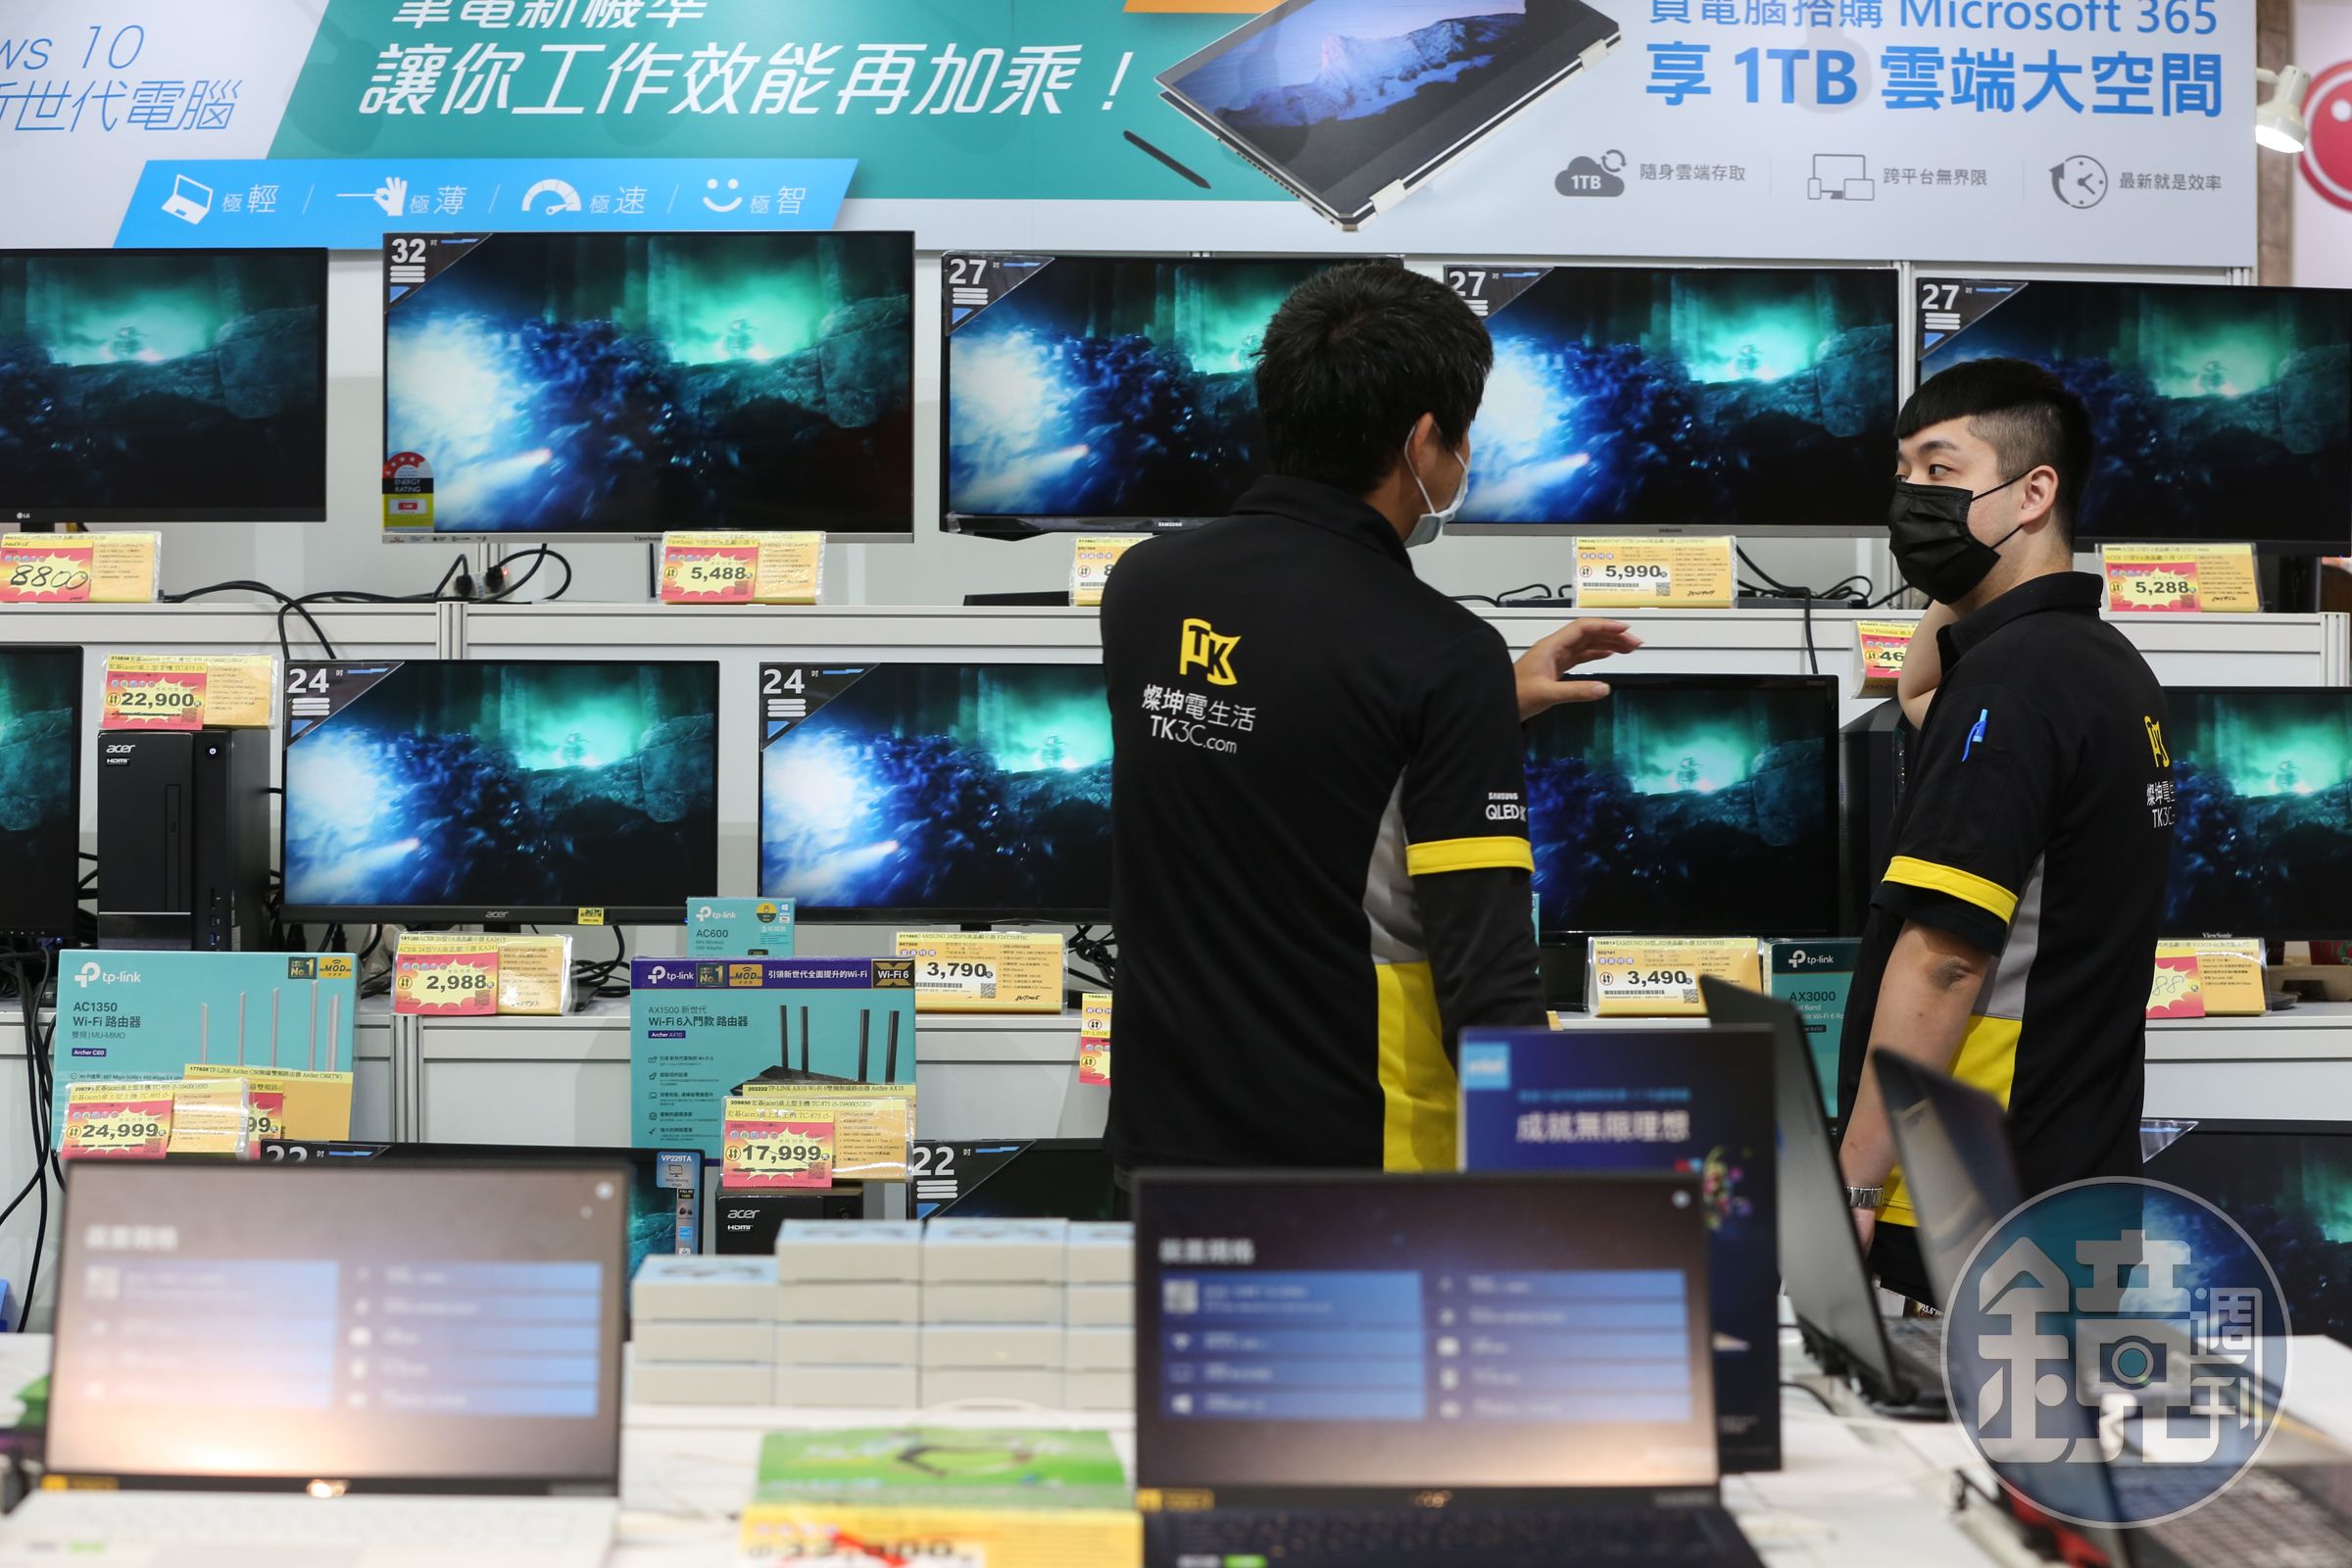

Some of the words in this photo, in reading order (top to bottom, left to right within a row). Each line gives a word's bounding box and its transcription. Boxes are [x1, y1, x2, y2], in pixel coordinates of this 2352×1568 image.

[1899, 0, 2120, 33] Microsoft
[2135, 0, 2218, 35] 365
[82, 24, 145, 70] 10
[1645, 41, 1711, 106] 享
[1734, 47, 1858, 106] 1TB
[1880, 45, 2223, 118] 雲端大空間
[1639, 163, 1746, 182] 隨身雲端存取
[1883, 168, 1988, 187] 跨平台無界限
[2119, 172, 2223, 191] 最新就是效率
[1570, 174, 1602, 190] 1TB
[220, 184, 280, 214] 極輕
[409, 185, 467, 215] 極薄
[588, 185, 647, 214] 極速
[749, 185, 807, 215] 極智
[391, 238, 426, 264] 32
[949, 258, 988, 284] 27
[1449, 270, 1487, 297] 27
[1921, 283, 1960, 310] 27
[10, 564, 89, 590] 8800
[691, 566, 746, 582] 5,488
[1605, 564, 1661, 581] 5,990
[2135, 581, 2189, 597] 5,288
[286, 668, 329, 694] 24
[762, 668, 805, 695] 24
[121, 692, 195, 710] 22,900
[1142, 683, 1256, 732] 燦坤電生活
[1151, 714, 1238, 754] TK3C.com
[106, 744, 136, 754] acer
[1488, 792, 1519, 801] SAMSUNG
[1486, 804, 1520, 820] QLED
[711, 910, 737, 920] tp-link
[696, 928, 729, 939] AC600
[1807, 956, 1835, 965] tp-link
[102, 970, 141, 985] tp-link
[666, 970, 695, 982] tp-link
[877, 969, 902, 979] Wi-Fi
[903, 970, 909, 979] 6
[926, 961, 987, 979] 3,790
[1628, 970, 1688, 988] 3,490
[426, 974, 487, 992] 2,988
[1789, 991, 1837, 1002] AX3000
[74, 1002, 119, 1012] AC1350
[648, 1005, 680, 1014] AX1500
[681, 1005, 708, 1014] 新世代
[73, 1016, 103, 1027] Wi-Fi
[105, 1015, 141, 1028] 路由器
[649, 1016, 674, 1026] Wi-Fi
[716, 1015, 749, 1027] 路由器
[81, 1123, 159, 1141] 24,999
[742, 1145, 821, 1163] 17,999
[912, 1146, 955, 1176] 22
[727, 1208, 760, 1219] acer
